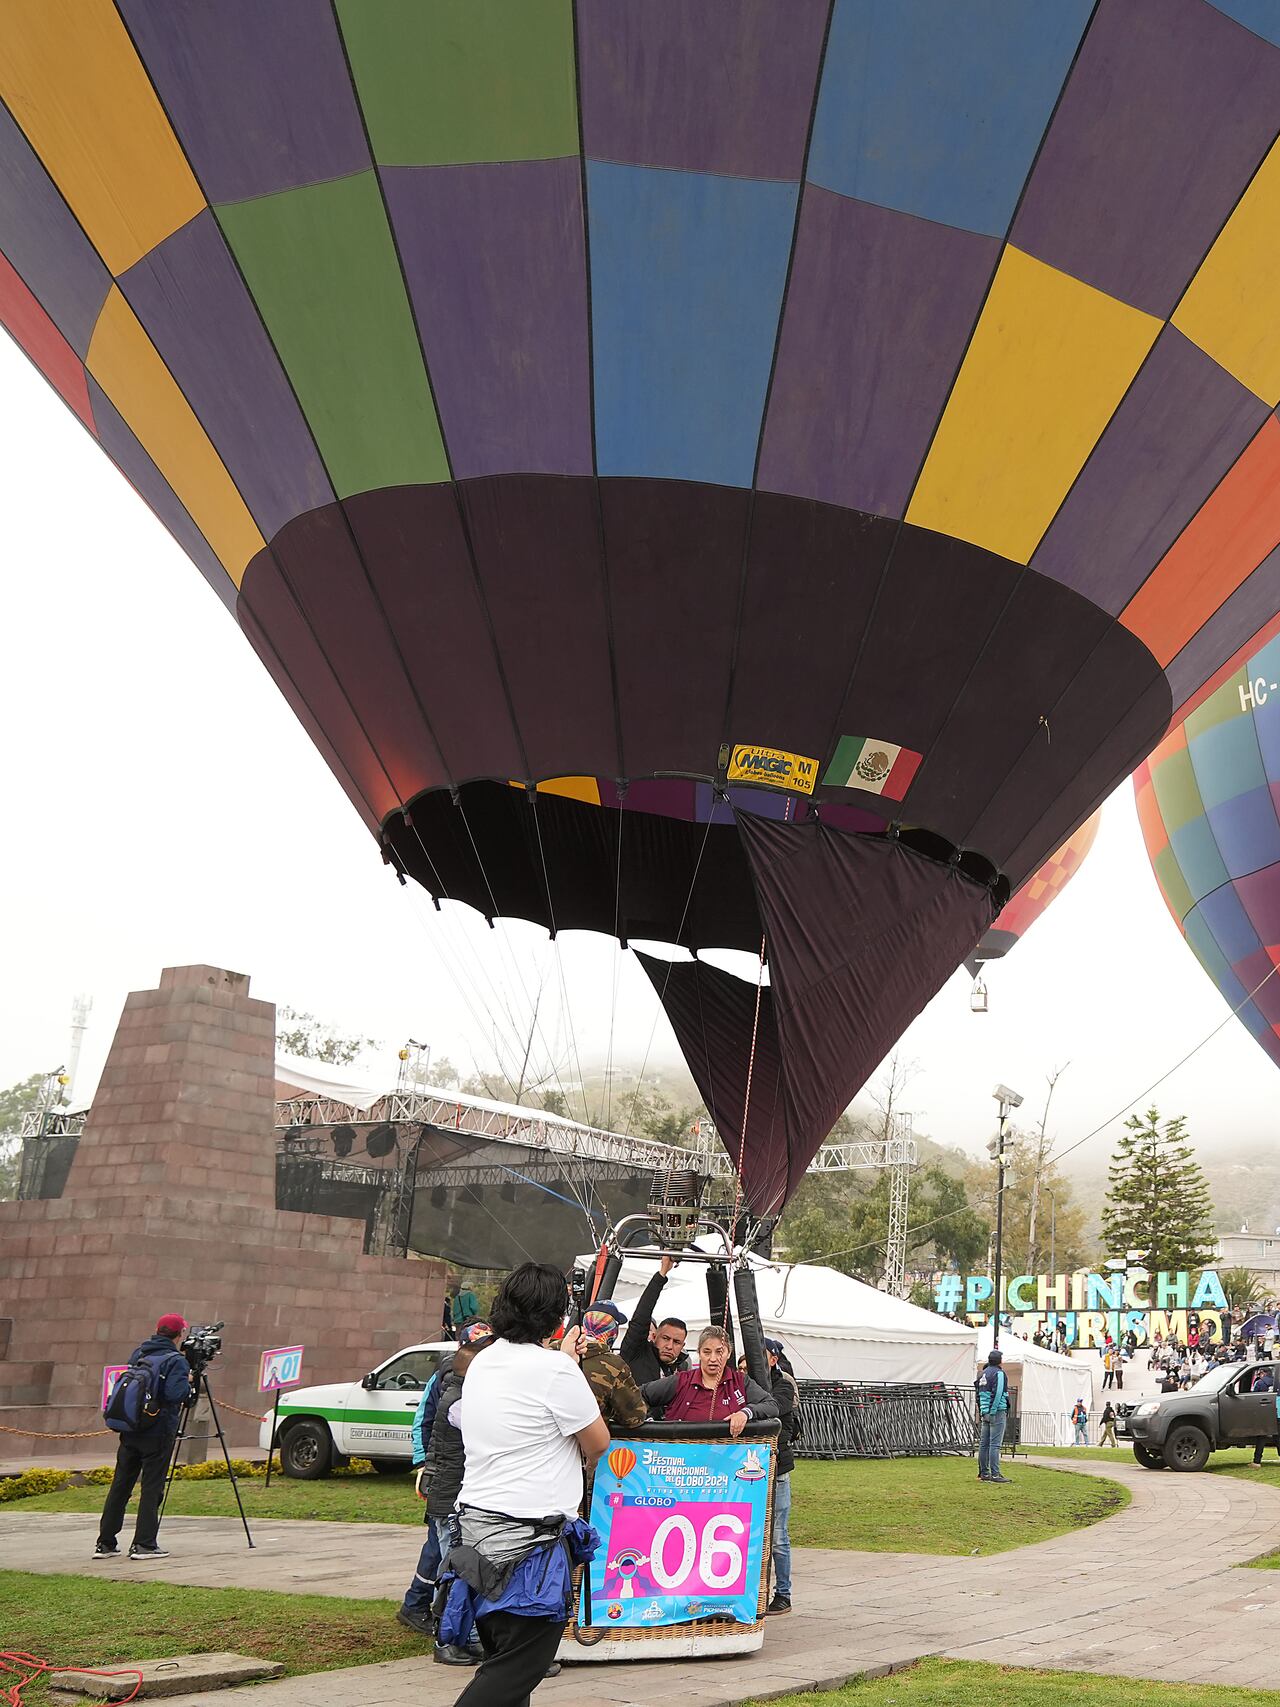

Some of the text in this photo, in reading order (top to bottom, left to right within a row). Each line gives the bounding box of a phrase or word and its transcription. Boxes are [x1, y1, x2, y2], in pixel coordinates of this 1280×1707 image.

[739, 753, 793, 776] MAGIC
[797, 761, 812, 775] M
[793, 777, 812, 789] 105
[934, 1271, 1229, 1312] #PICHINCHA
[281, 1355, 300, 1380] 01
[652, 1456, 686, 1466] FESTIVAL
[649, 1465, 709, 1476] INTERNACIONAL
[675, 1475, 704, 1487] GLOBO
[704, 1475, 728, 1487] 2024
[634, 1496, 672, 1507] GLOBO
[650, 1513, 745, 1590] 06
